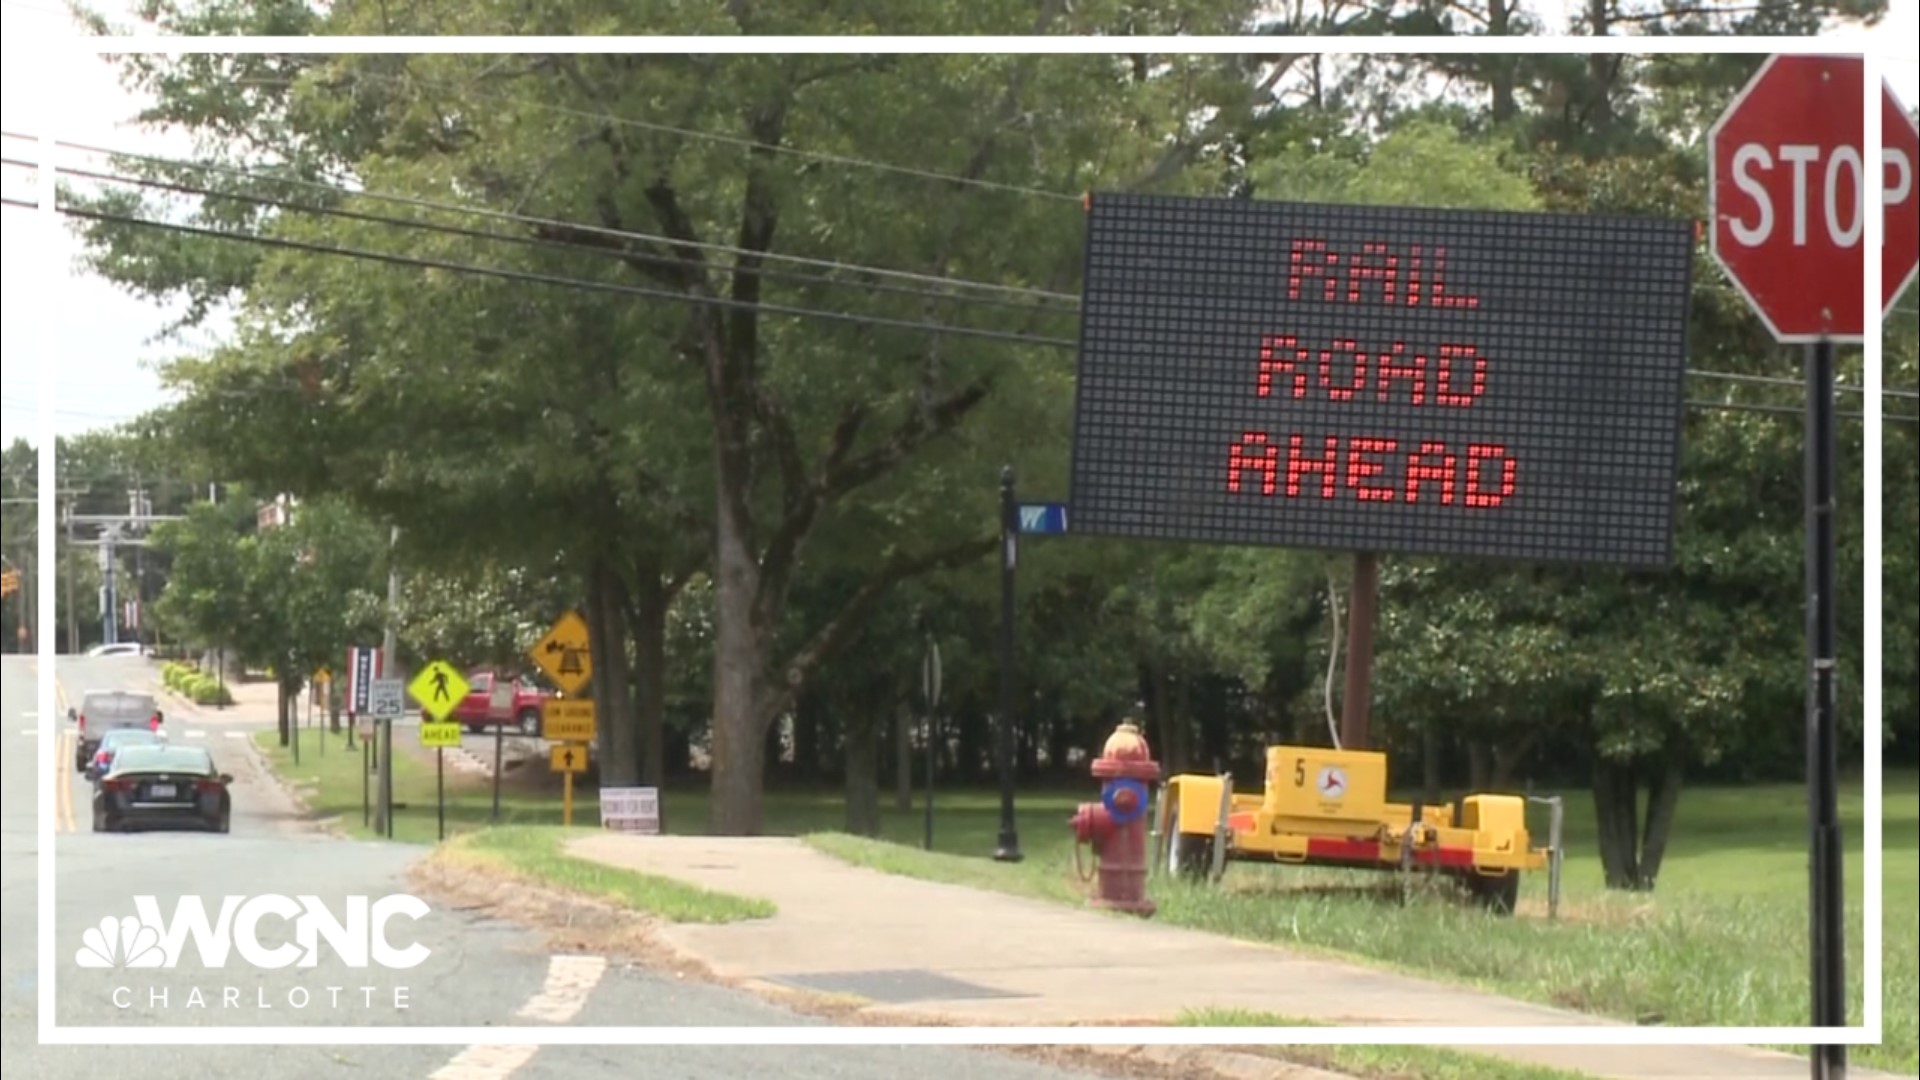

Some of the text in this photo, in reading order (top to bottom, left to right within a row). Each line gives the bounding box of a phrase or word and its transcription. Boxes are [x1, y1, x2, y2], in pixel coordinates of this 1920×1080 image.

[1729, 143, 1912, 248] STOP
[1289, 239, 1479, 306] RAIL
[1257, 334, 1487, 406] ROAD
[1228, 432, 1516, 507] AHEAD
[376, 699, 400, 715] 25
[423, 728, 457, 740] AHEAD
[1295, 758, 1305, 789] 5
